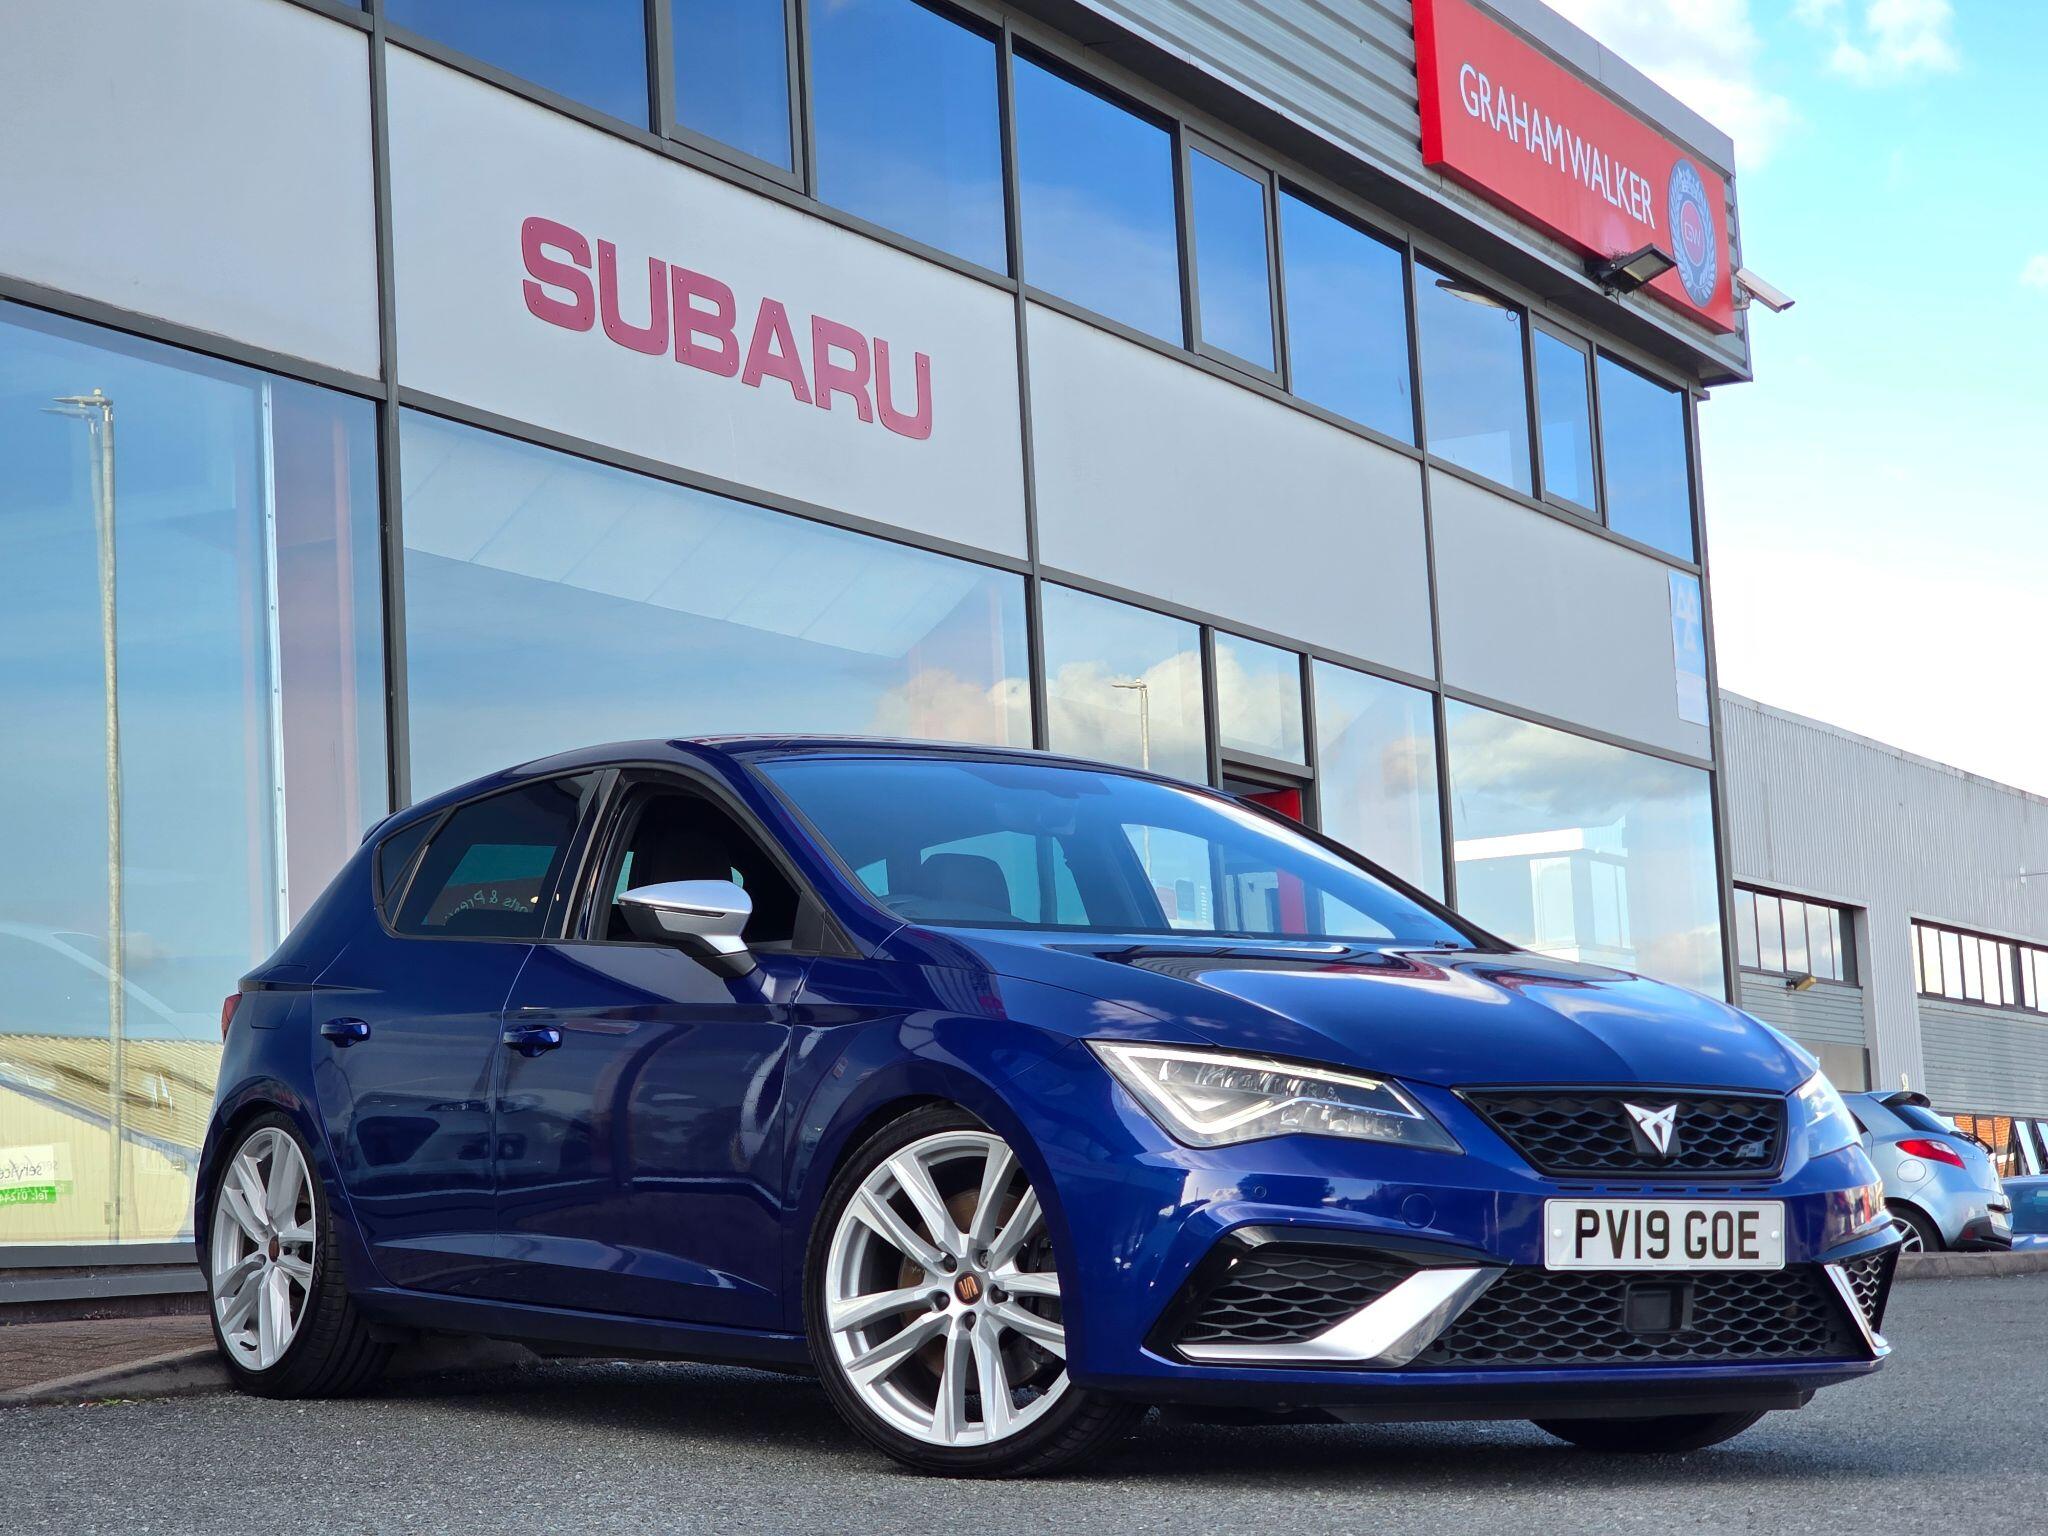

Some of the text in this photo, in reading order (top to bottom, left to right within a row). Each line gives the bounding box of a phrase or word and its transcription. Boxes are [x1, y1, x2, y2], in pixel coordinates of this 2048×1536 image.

[1459, 63, 1656, 230] GRAHAM WALKER
[521, 216, 932, 440] SUBARU
[1575, 1208, 1760, 1260] PV19 GOE
